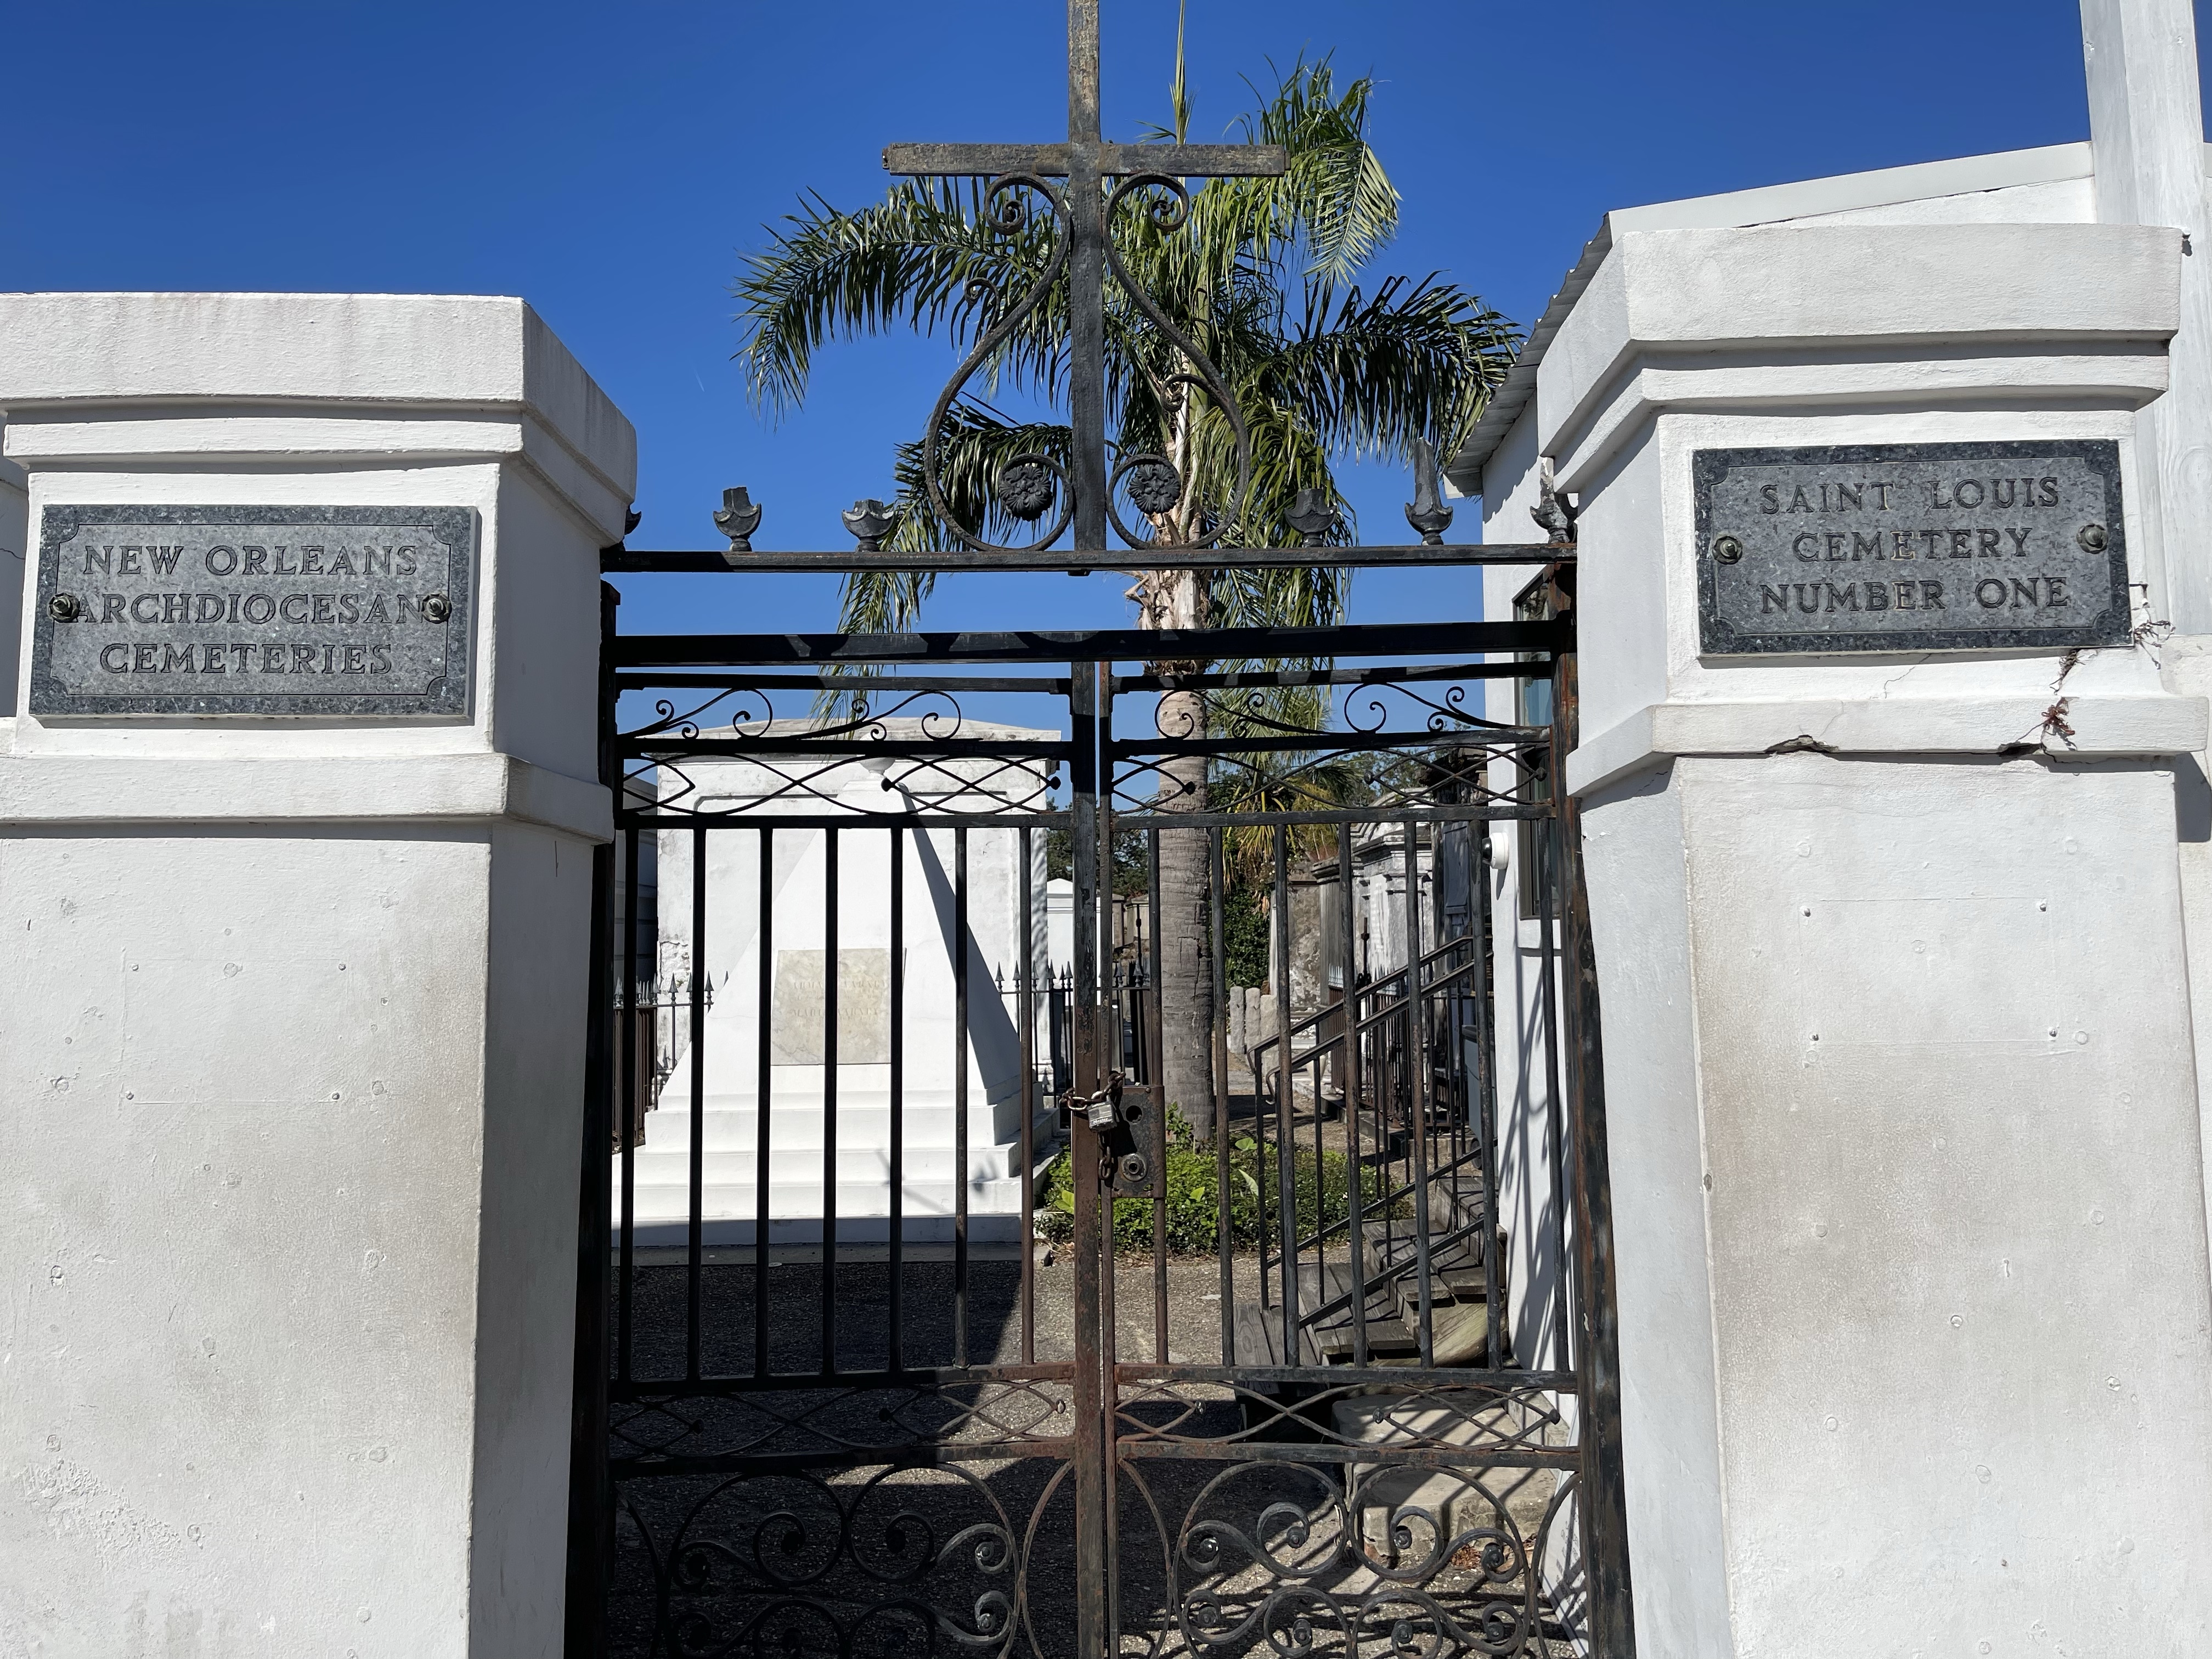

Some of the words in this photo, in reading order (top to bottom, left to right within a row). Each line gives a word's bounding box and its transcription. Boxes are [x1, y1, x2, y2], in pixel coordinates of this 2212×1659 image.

[1760, 483, 1894, 515] SAINT
[1929, 476, 2059, 510] LOUIS
[83, 545, 184, 575] NEW
[205, 545, 417, 575] ORLEANS
[1792, 527, 2032, 562] CEMETERY
[72, 593, 427, 624] ARCHDIOCESAN
[1760, 580, 1946, 614] NUMBER
[1975, 577, 2069, 610] ONE
[100, 643, 392, 675] CEMETERIES
